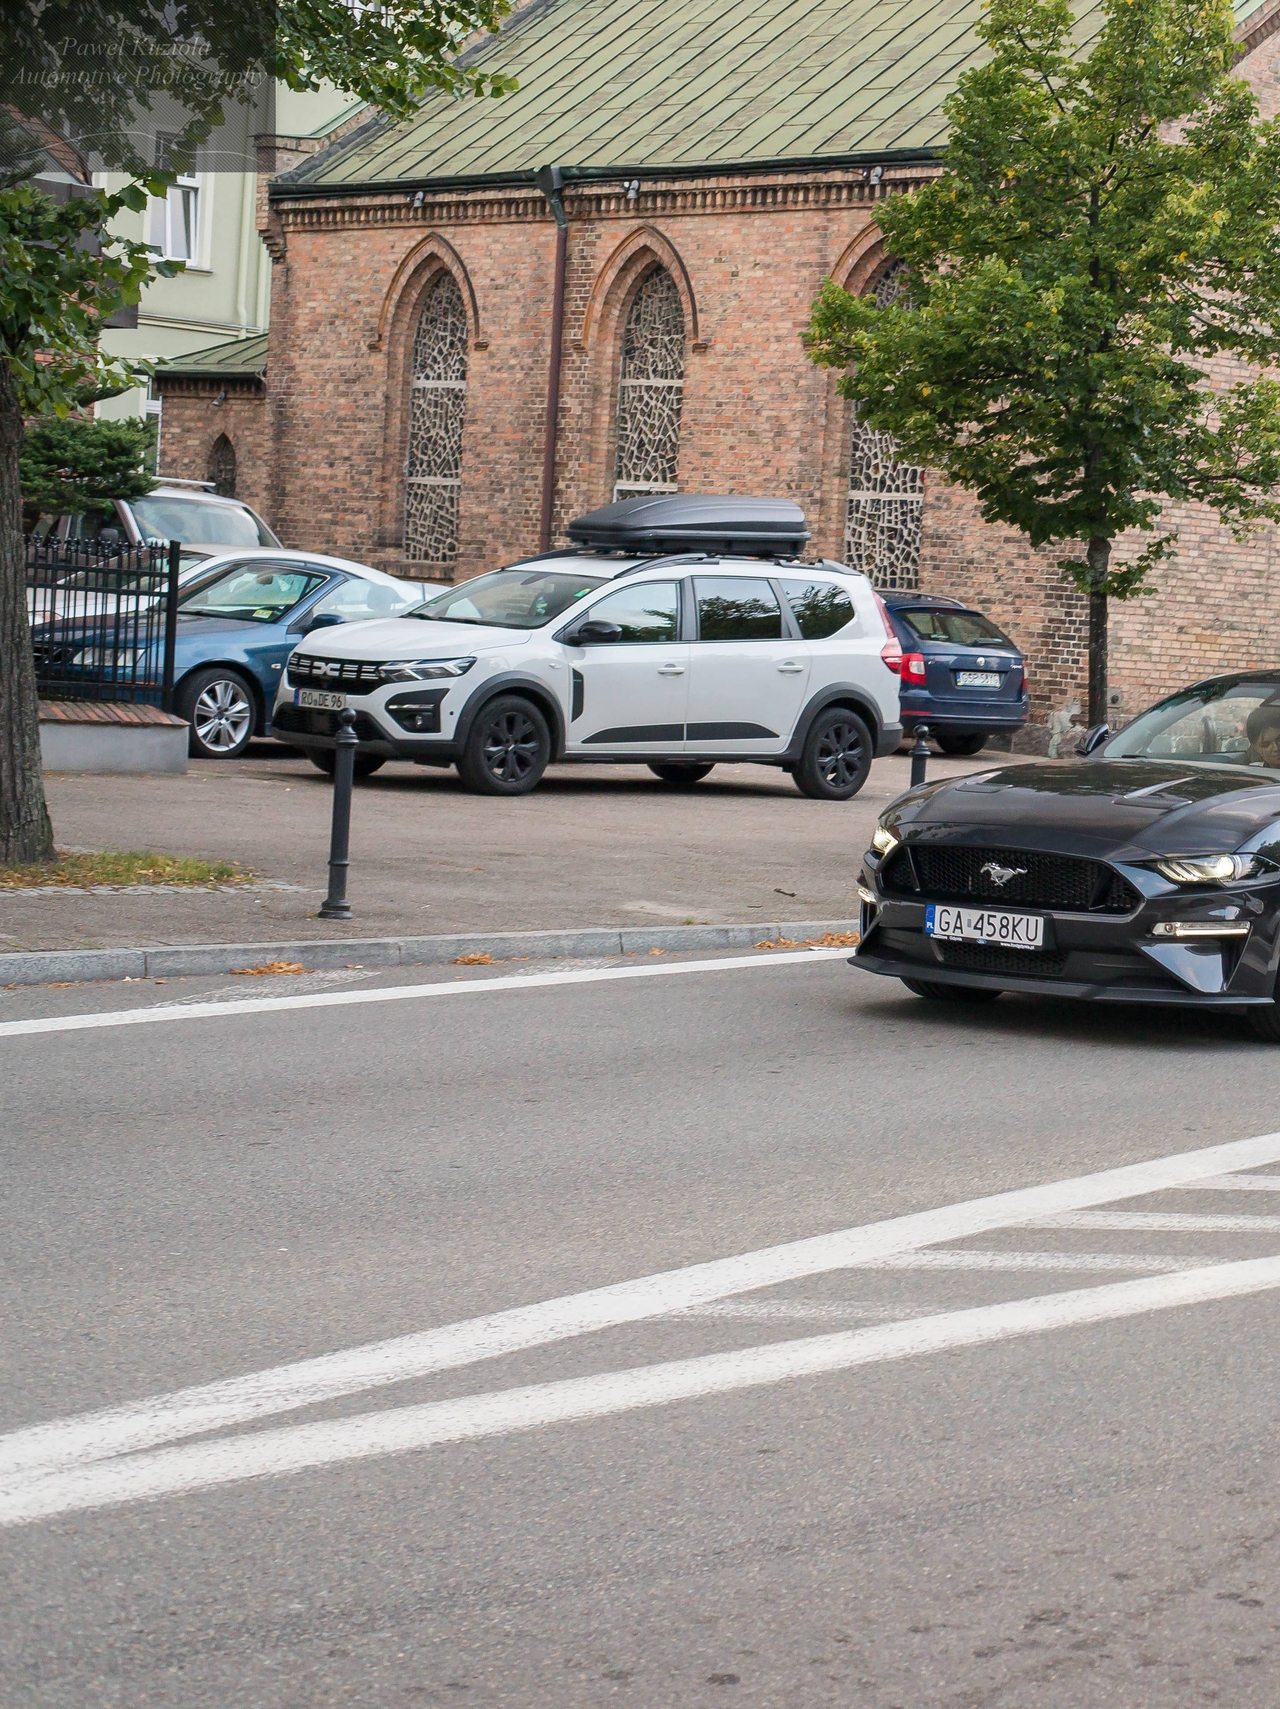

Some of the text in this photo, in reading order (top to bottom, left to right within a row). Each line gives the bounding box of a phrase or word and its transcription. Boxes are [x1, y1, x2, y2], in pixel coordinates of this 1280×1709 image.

[331, 694, 343, 708] 96
[926, 921, 934, 929] PL
[939, 908, 1039, 942] GA 458KU
